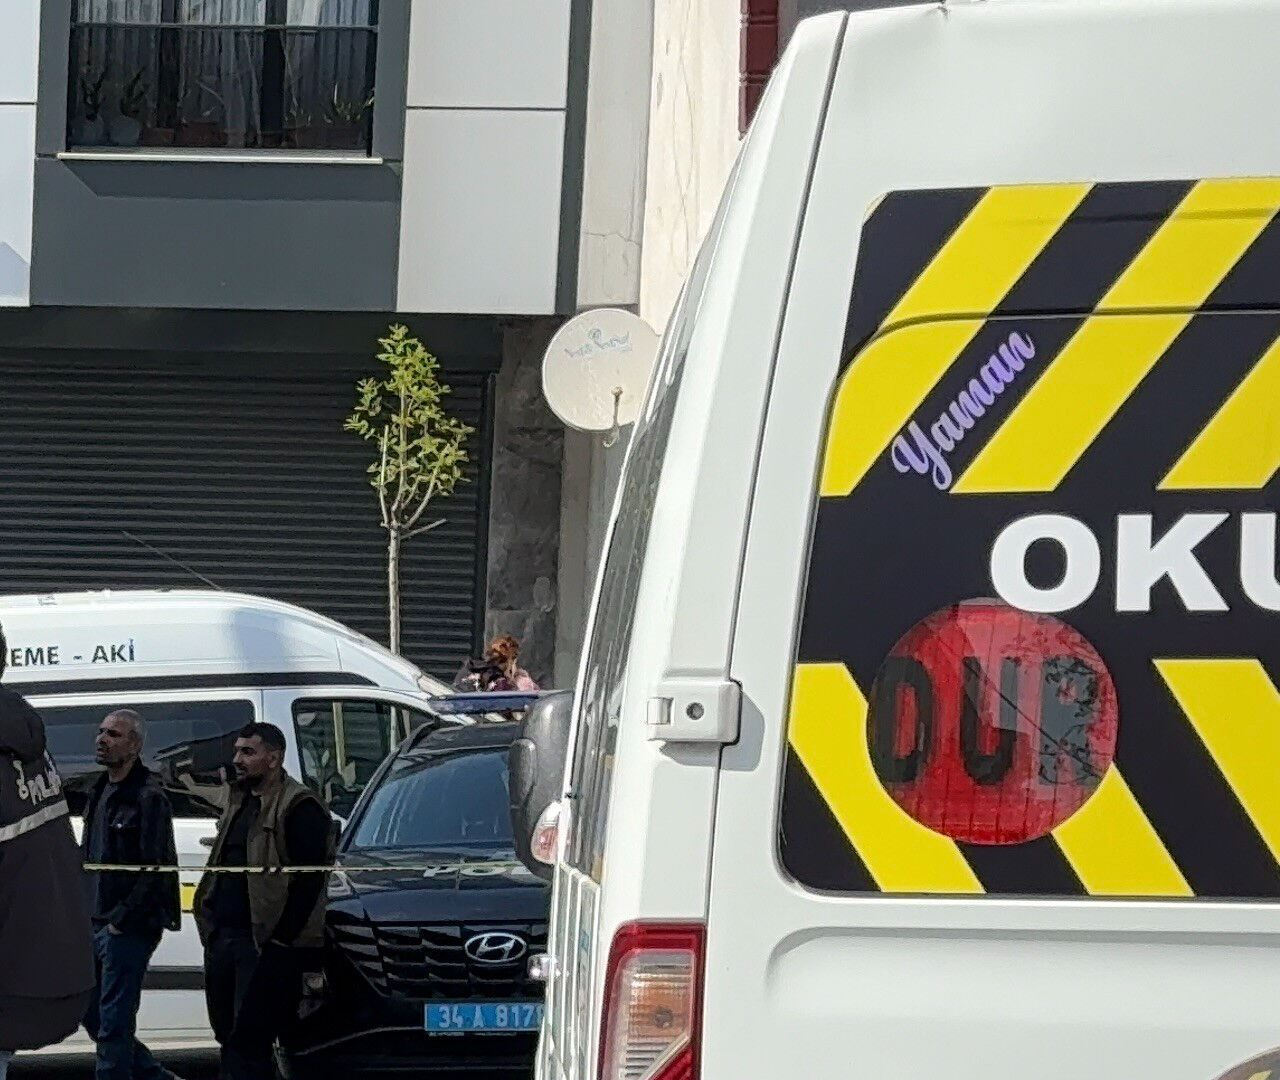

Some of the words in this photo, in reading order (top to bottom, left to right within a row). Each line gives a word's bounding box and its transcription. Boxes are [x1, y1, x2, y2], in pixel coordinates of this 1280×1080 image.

[891, 331, 1037, 491] Yaman
[6, 645, 60, 667] EME
[91, 638, 136, 664] AKİ
[874, 654, 1101, 787] DUR
[440, 1005, 464, 1028] 34
[495, 1004, 543, 1027] 817
